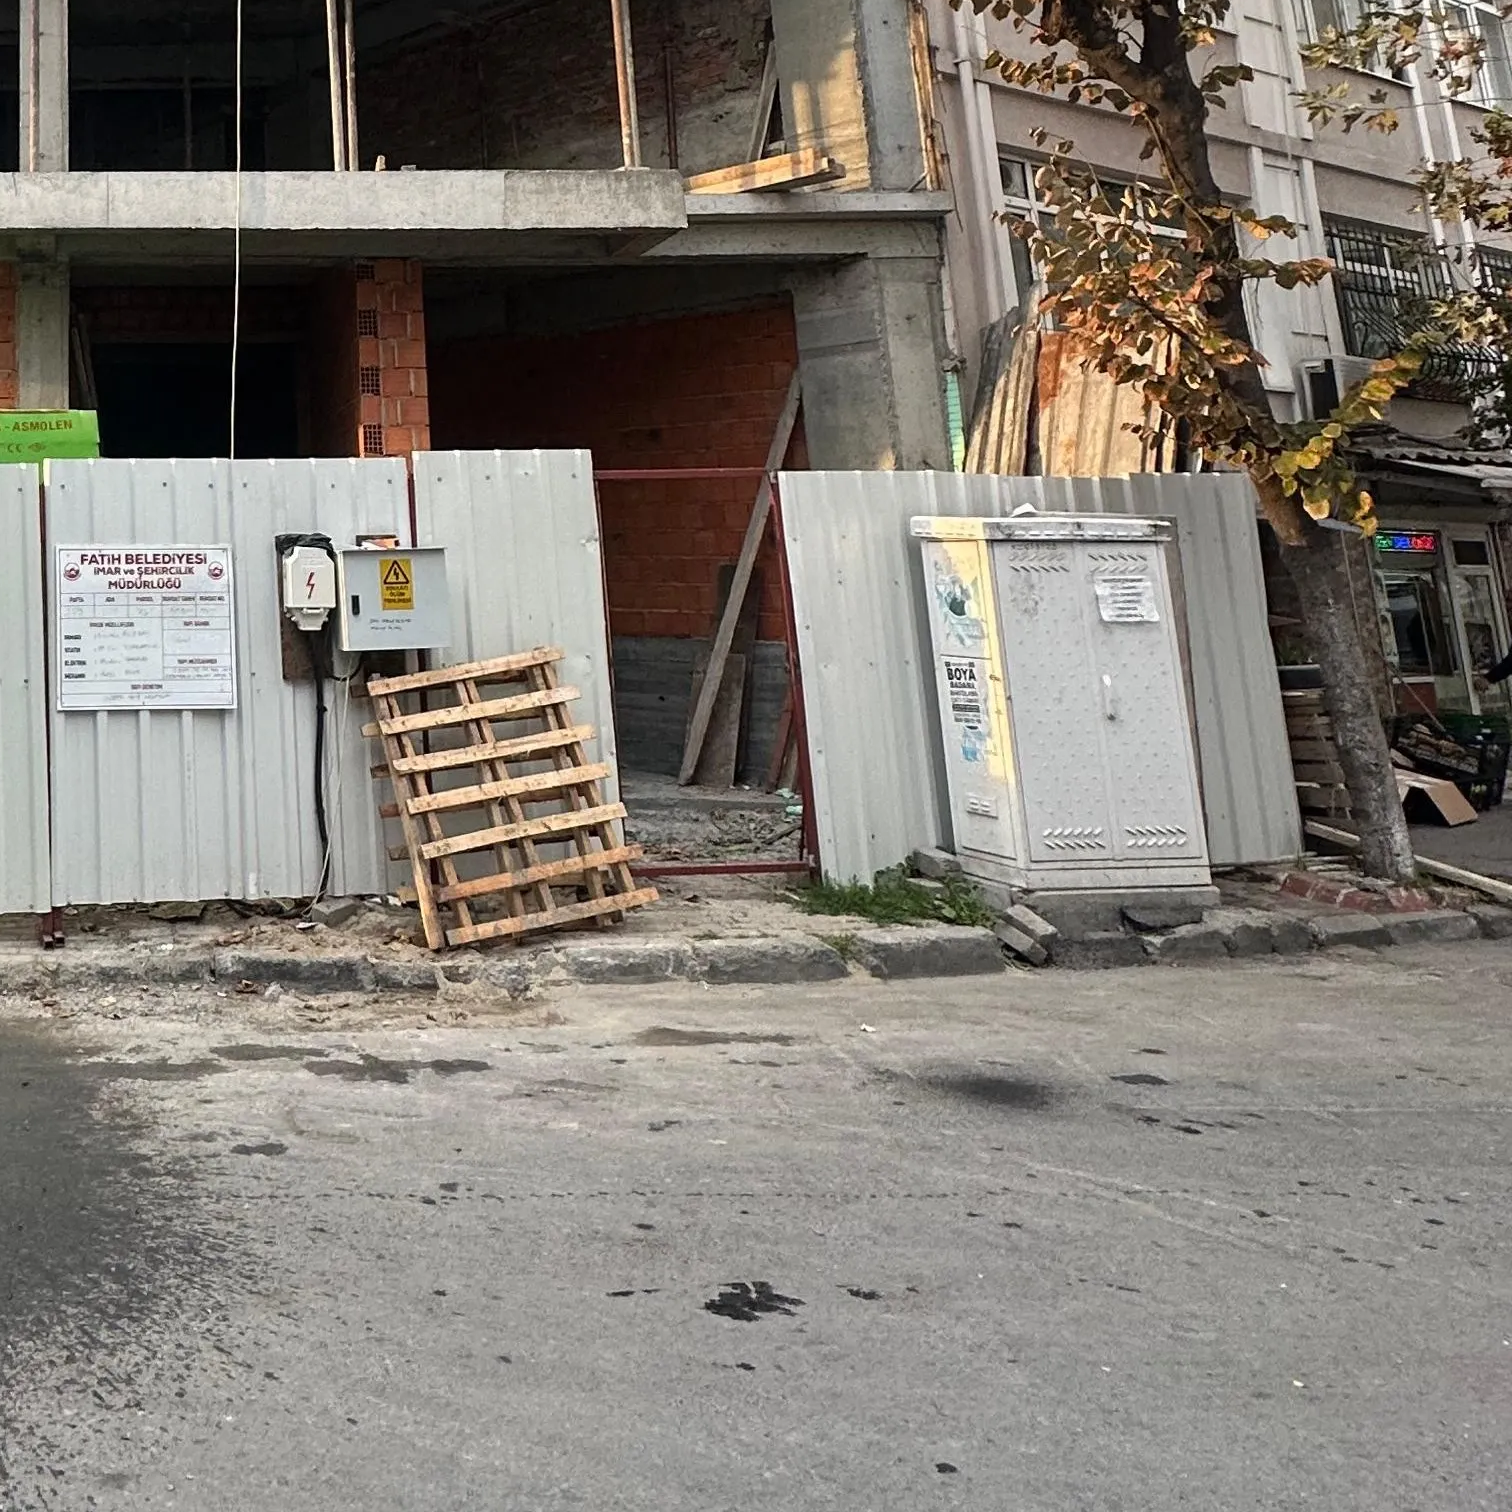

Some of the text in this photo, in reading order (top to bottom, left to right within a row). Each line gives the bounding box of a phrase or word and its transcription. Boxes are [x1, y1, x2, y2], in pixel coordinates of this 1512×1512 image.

[12, 419, 73, 432] ASMOLEN
[122, 568, 135, 576] ve
[946, 667, 977, 681] BOYA
